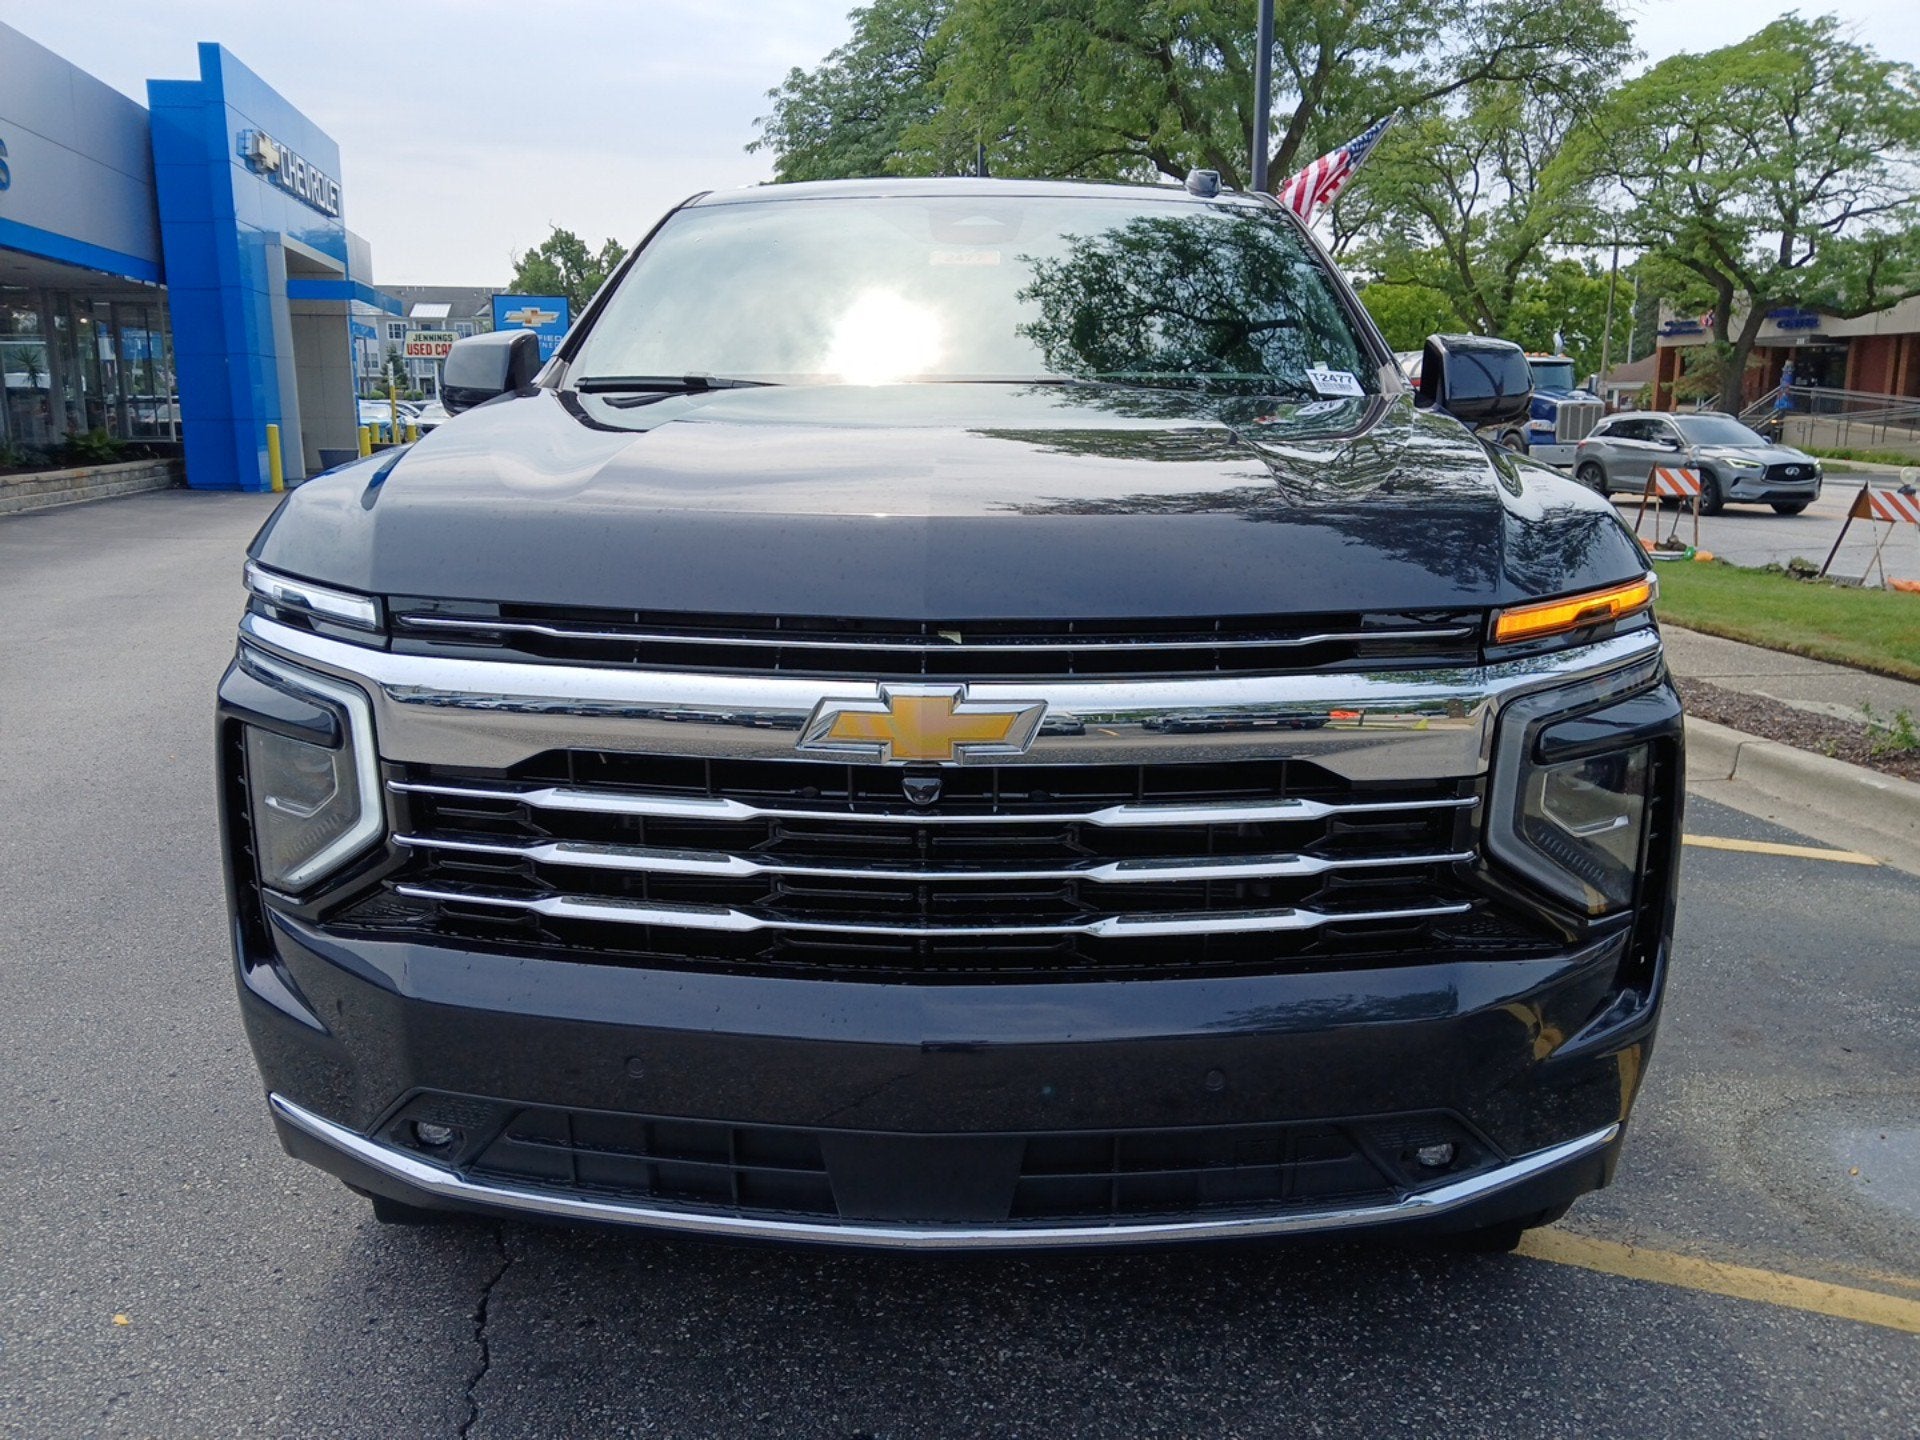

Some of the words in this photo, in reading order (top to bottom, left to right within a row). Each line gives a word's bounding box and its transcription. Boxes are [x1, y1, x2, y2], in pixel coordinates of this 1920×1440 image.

[280, 145, 341, 216] CHEVROLET
[407, 343, 432, 355] USED
[1311, 373, 1352, 384] T2477
